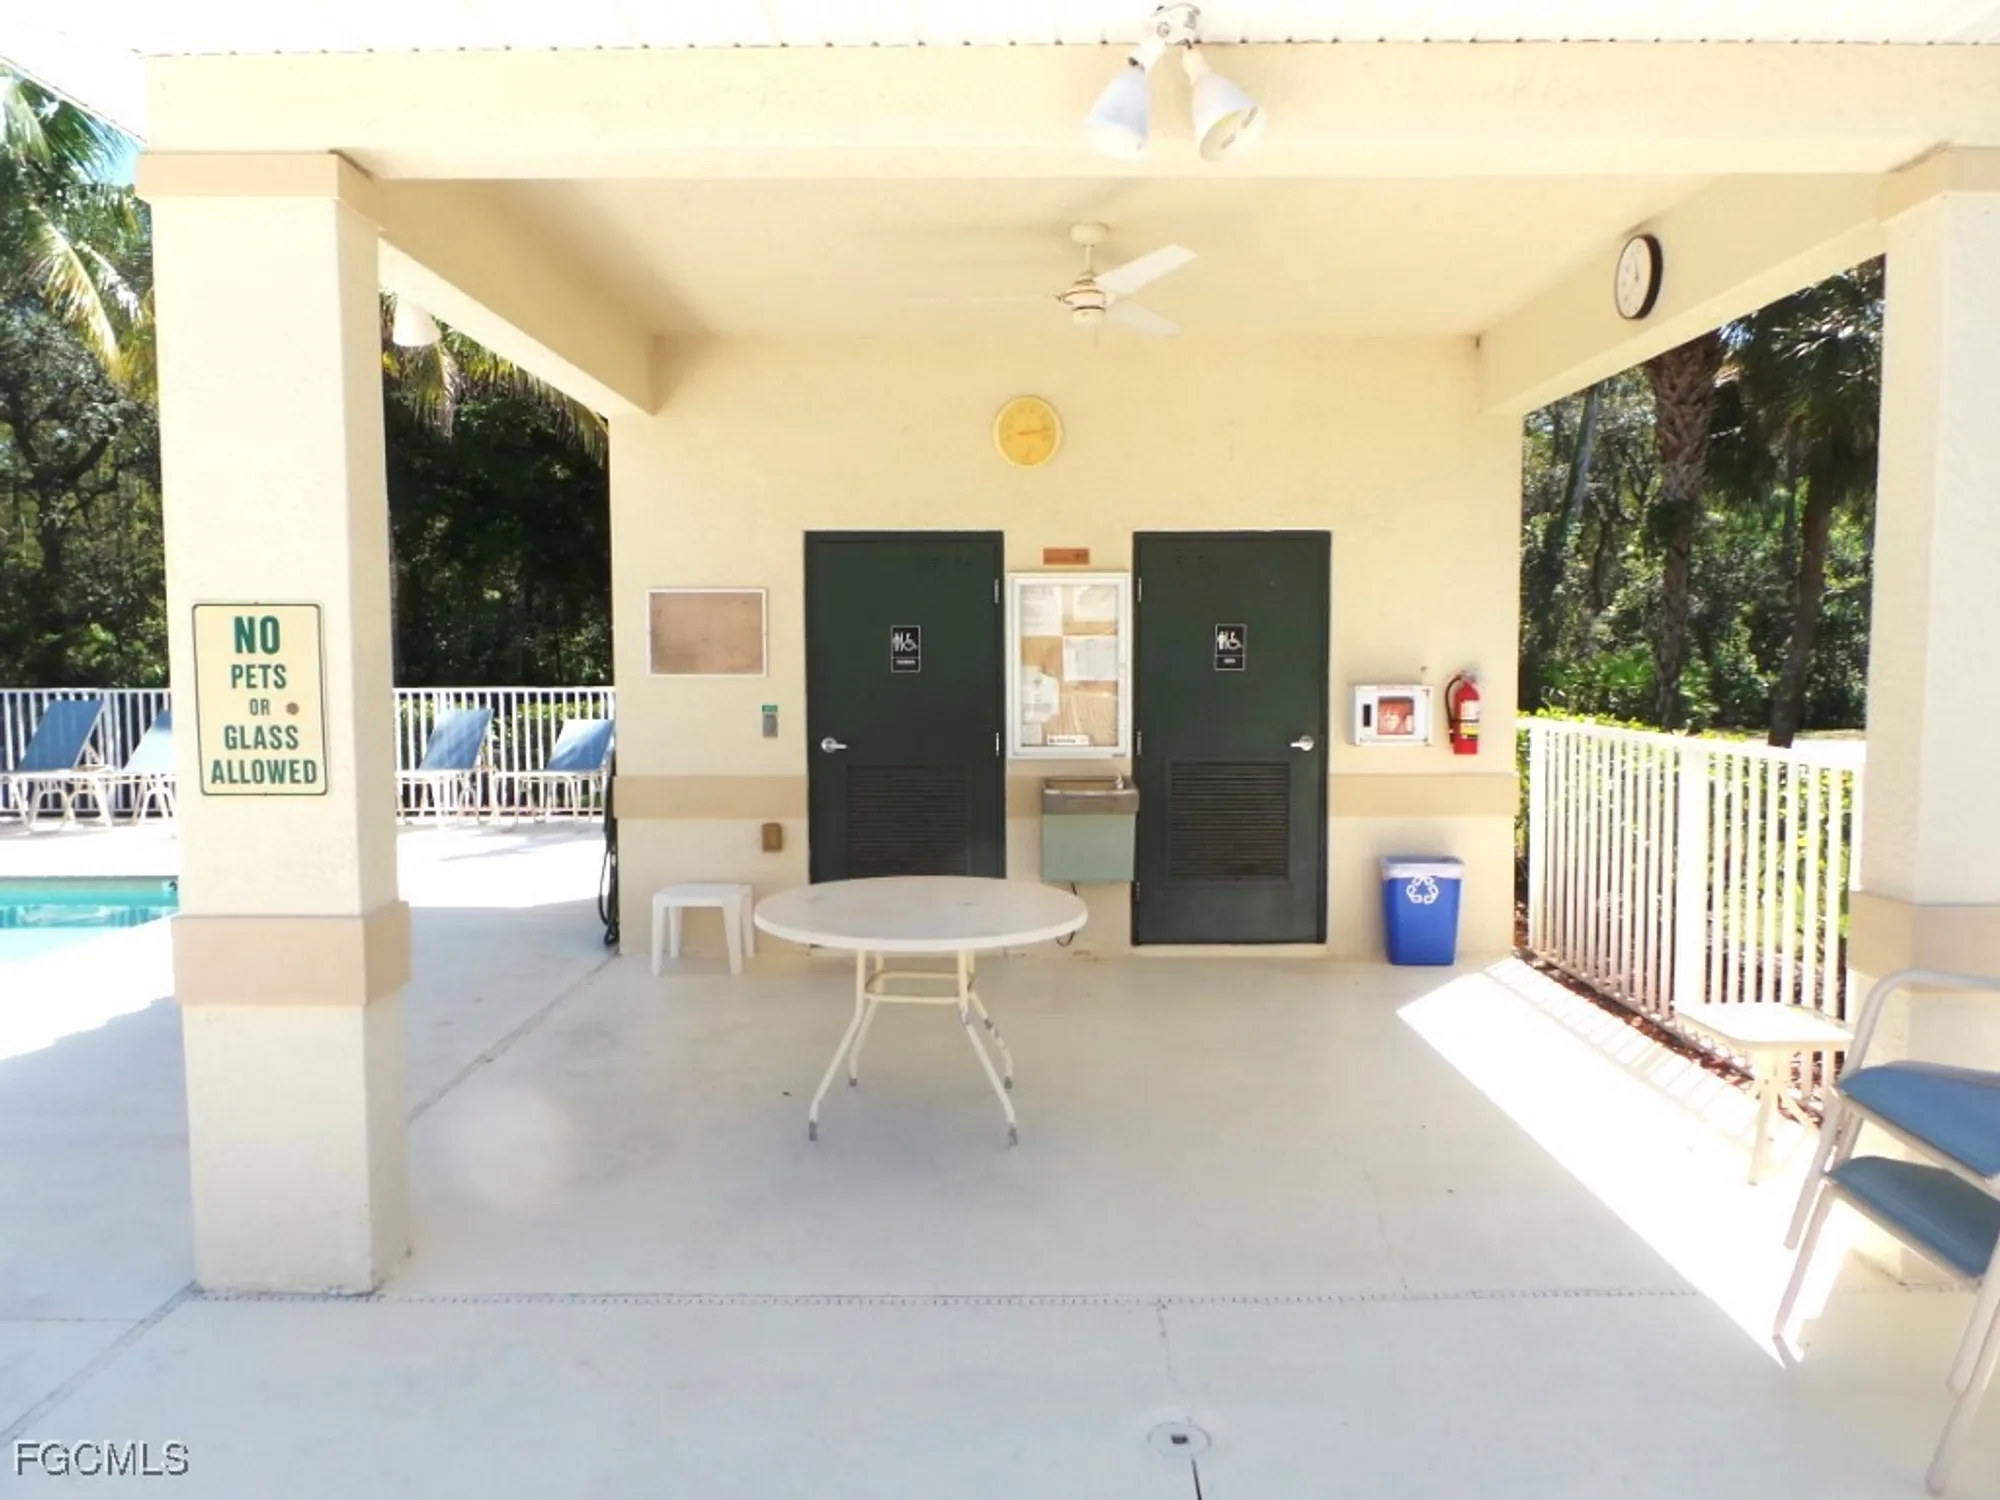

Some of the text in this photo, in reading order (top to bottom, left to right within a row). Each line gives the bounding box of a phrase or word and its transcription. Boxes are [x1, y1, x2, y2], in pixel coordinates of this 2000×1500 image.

[234, 615, 281, 655] NO
[231, 664, 287, 689] PETS
[249, 698, 271, 716] OR
[224, 725, 299, 751] GLASS
[211, 759, 318, 785] ALLOWED
